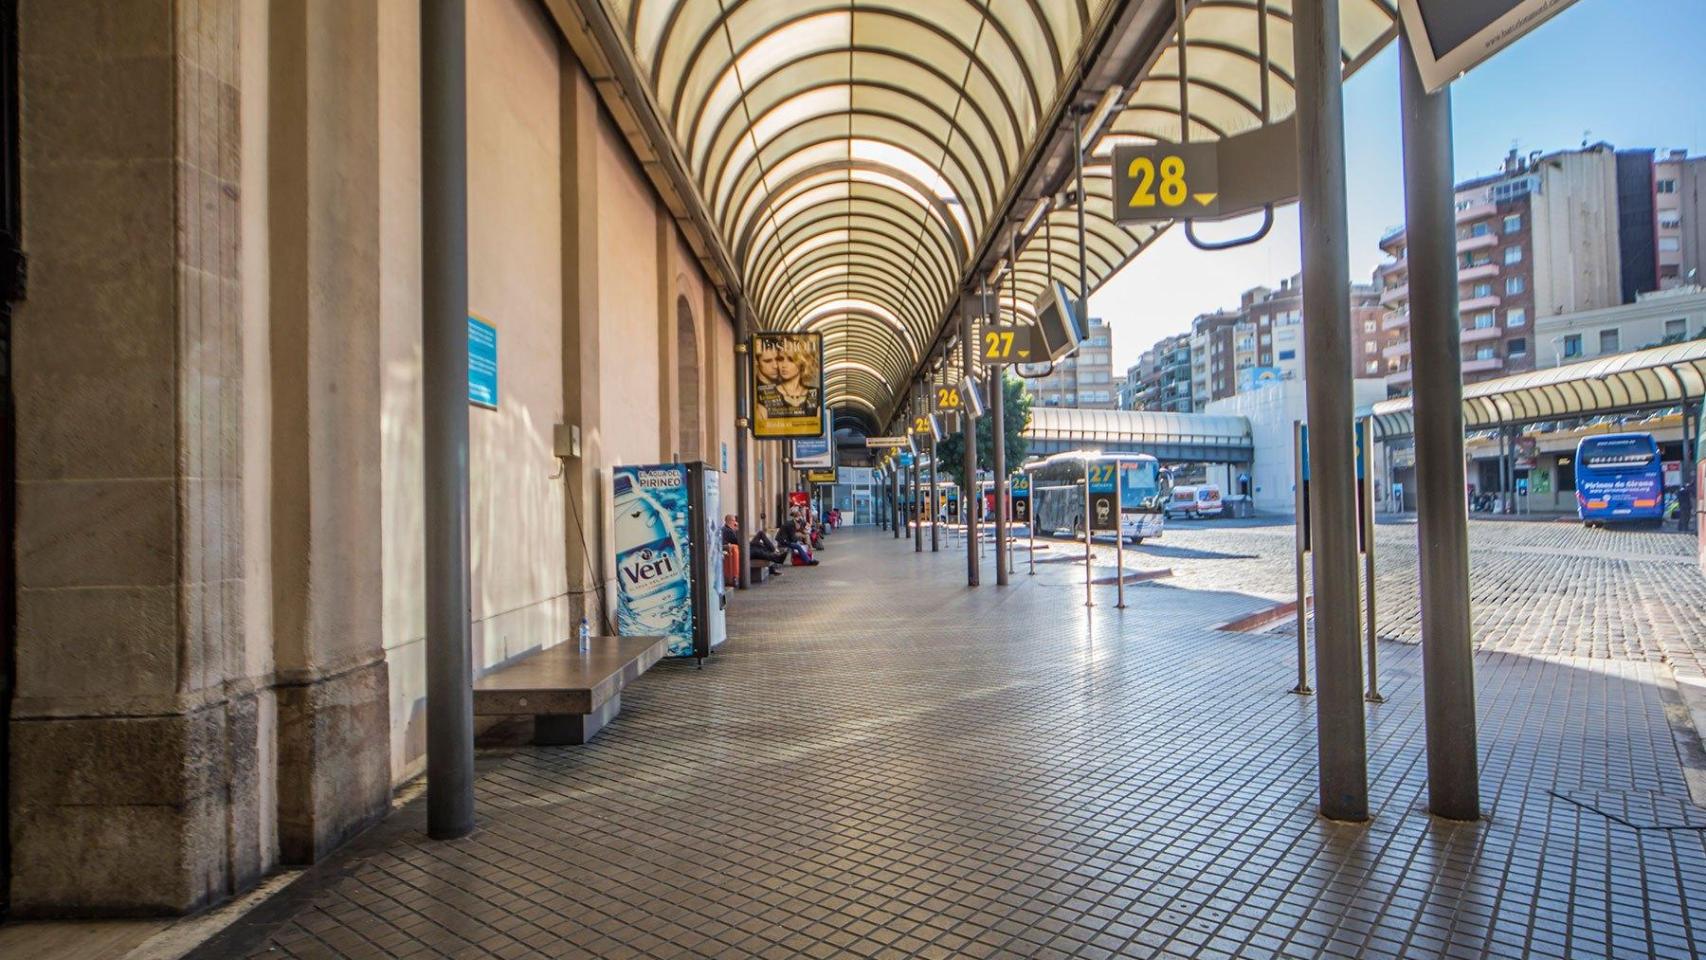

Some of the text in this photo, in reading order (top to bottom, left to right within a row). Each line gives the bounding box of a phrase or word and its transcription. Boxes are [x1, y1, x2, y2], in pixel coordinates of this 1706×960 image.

[1127, 155, 1188, 208] 28
[985, 331, 1015, 358] 27
[938, 388, 960, 408] 26
[640, 478, 680, 487] PIRINEO
[1089, 463, 1115, 482] 27
[1012, 477, 1029, 490] 26
[623, 552, 672, 584] Veri
